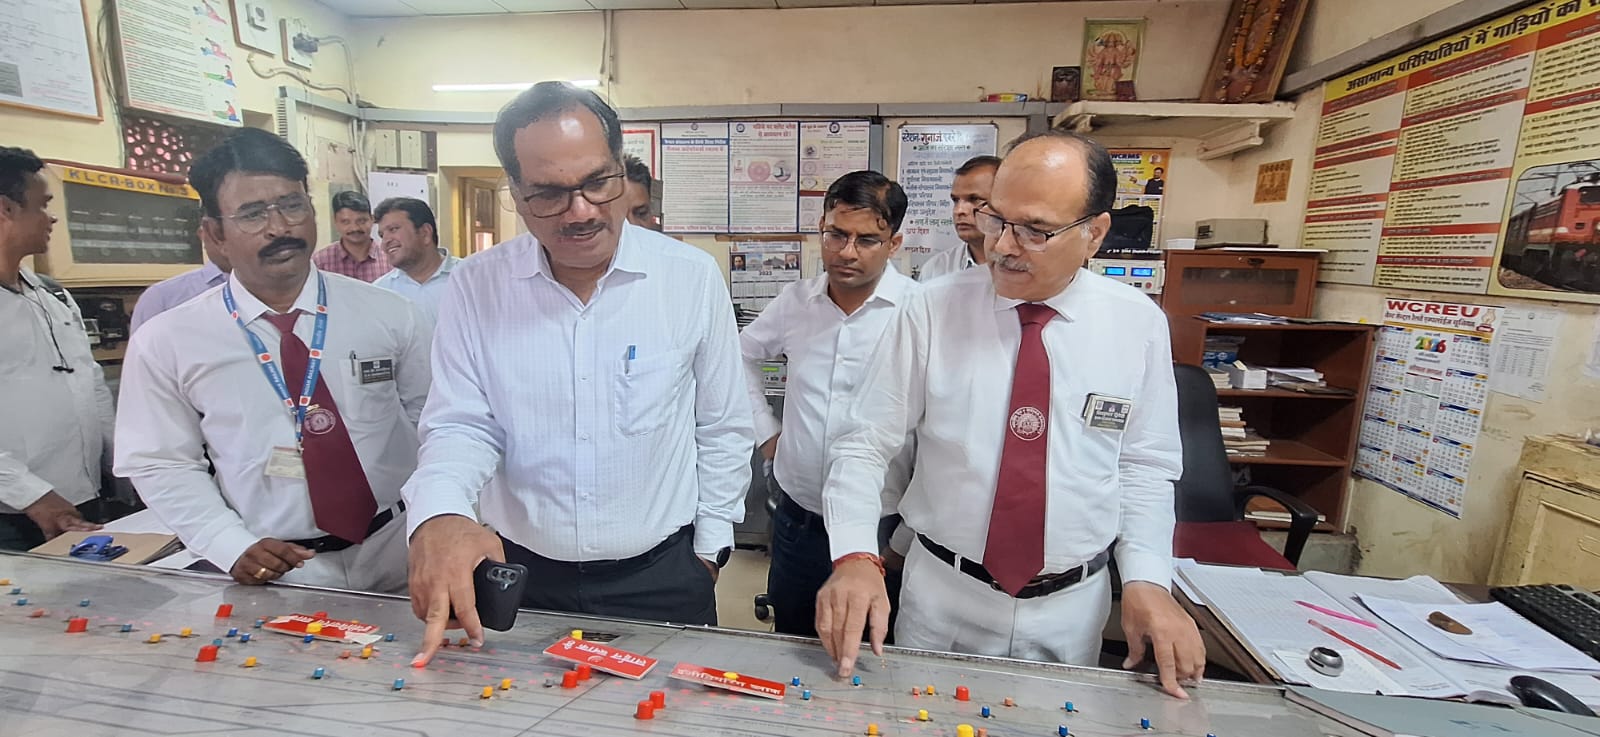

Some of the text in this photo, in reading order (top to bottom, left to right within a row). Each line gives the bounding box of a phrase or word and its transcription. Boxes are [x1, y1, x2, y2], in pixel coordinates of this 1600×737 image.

[1345, 64, 1397, 92] असामान्य
[1397, 33, 1472, 72] परिस्थितियों
[1474, 25, 1492, 46] में
[1493, 2, 1555, 37] गाड़ियों
[1387, 300, 1480, 318] WCREU
[1415, 335, 1447, 353] 2026
